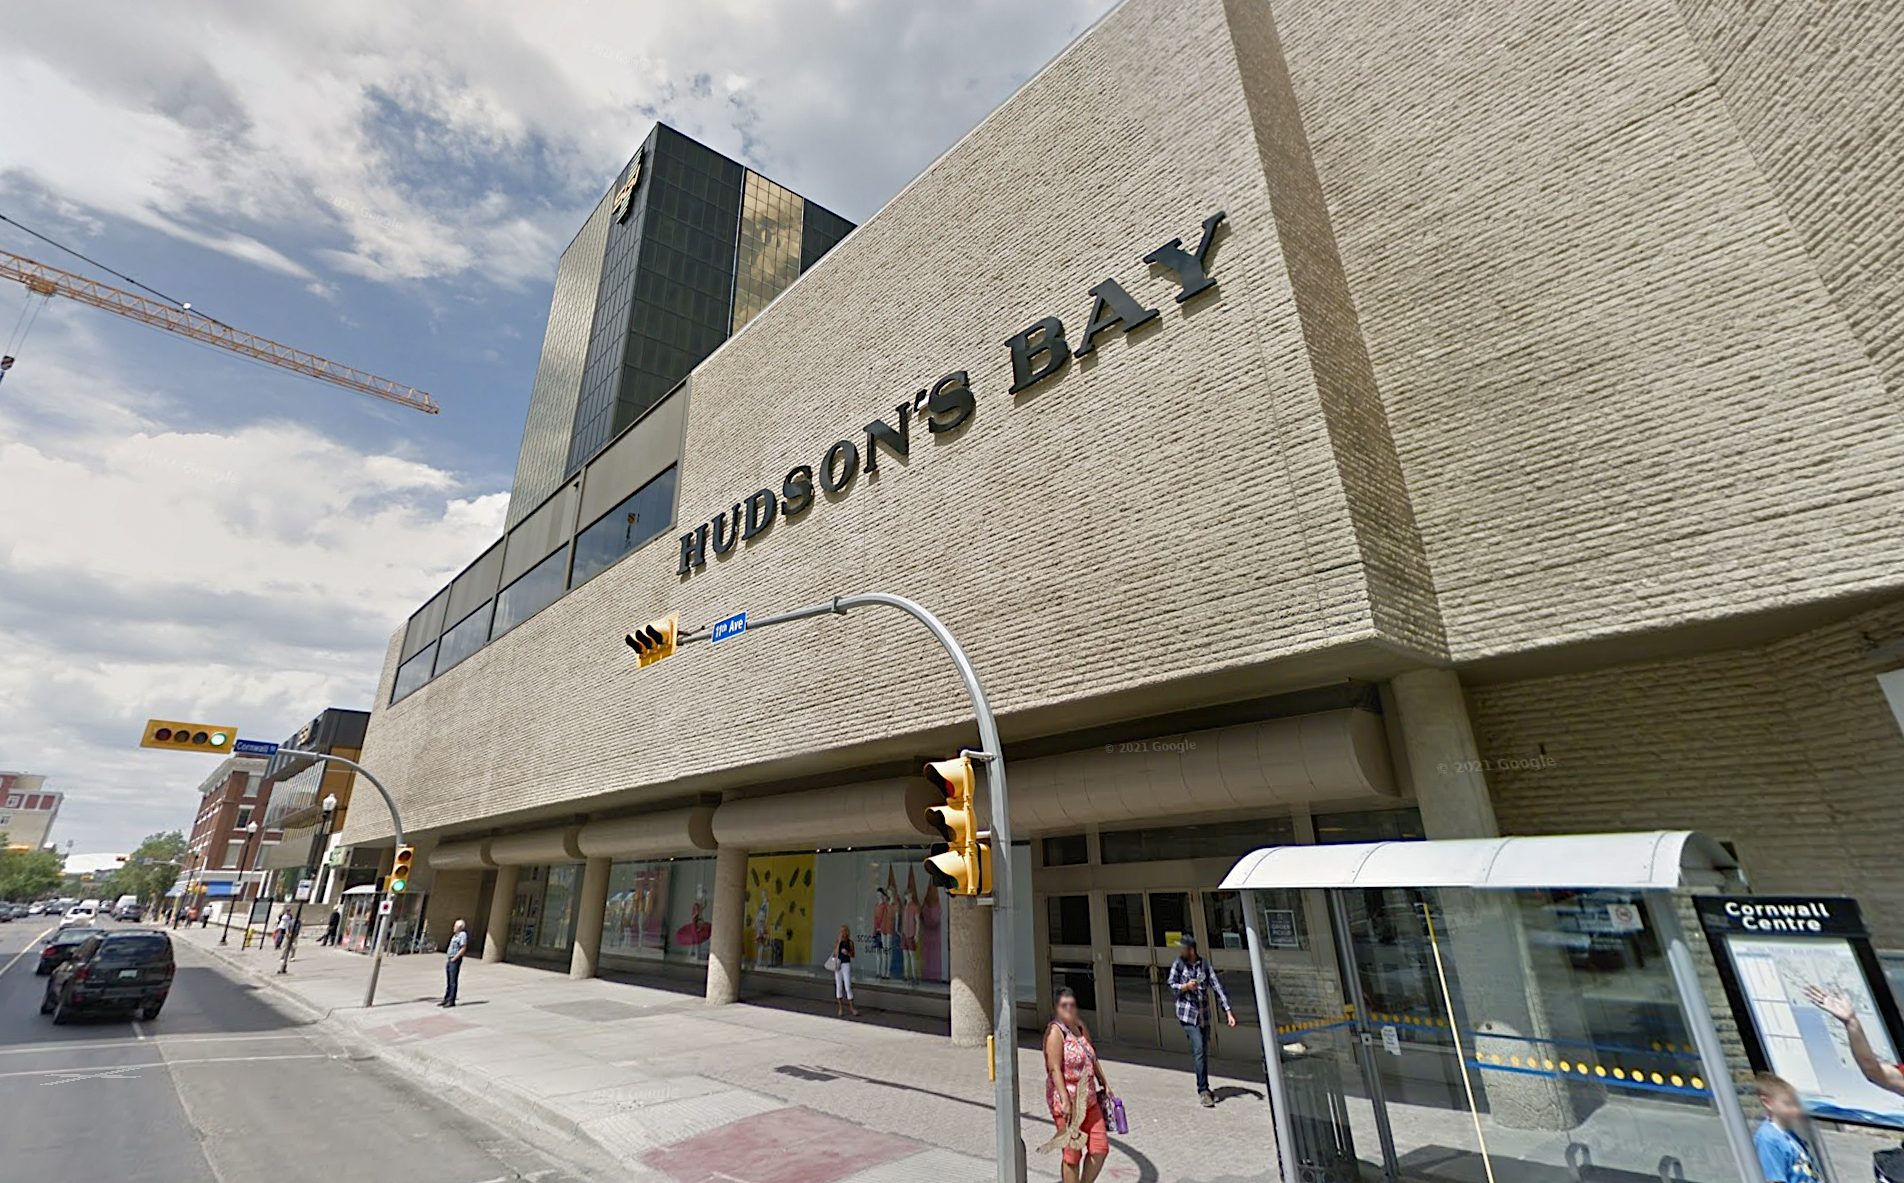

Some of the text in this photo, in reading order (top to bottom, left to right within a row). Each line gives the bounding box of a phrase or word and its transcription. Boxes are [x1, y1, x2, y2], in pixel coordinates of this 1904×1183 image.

[677, 210, 1226, 576] HUDSON'S BAY
[729, 619, 743, 633] Ave
[1724, 901, 1831, 918] Cornwall
[1741, 915, 1823, 932] Centre
